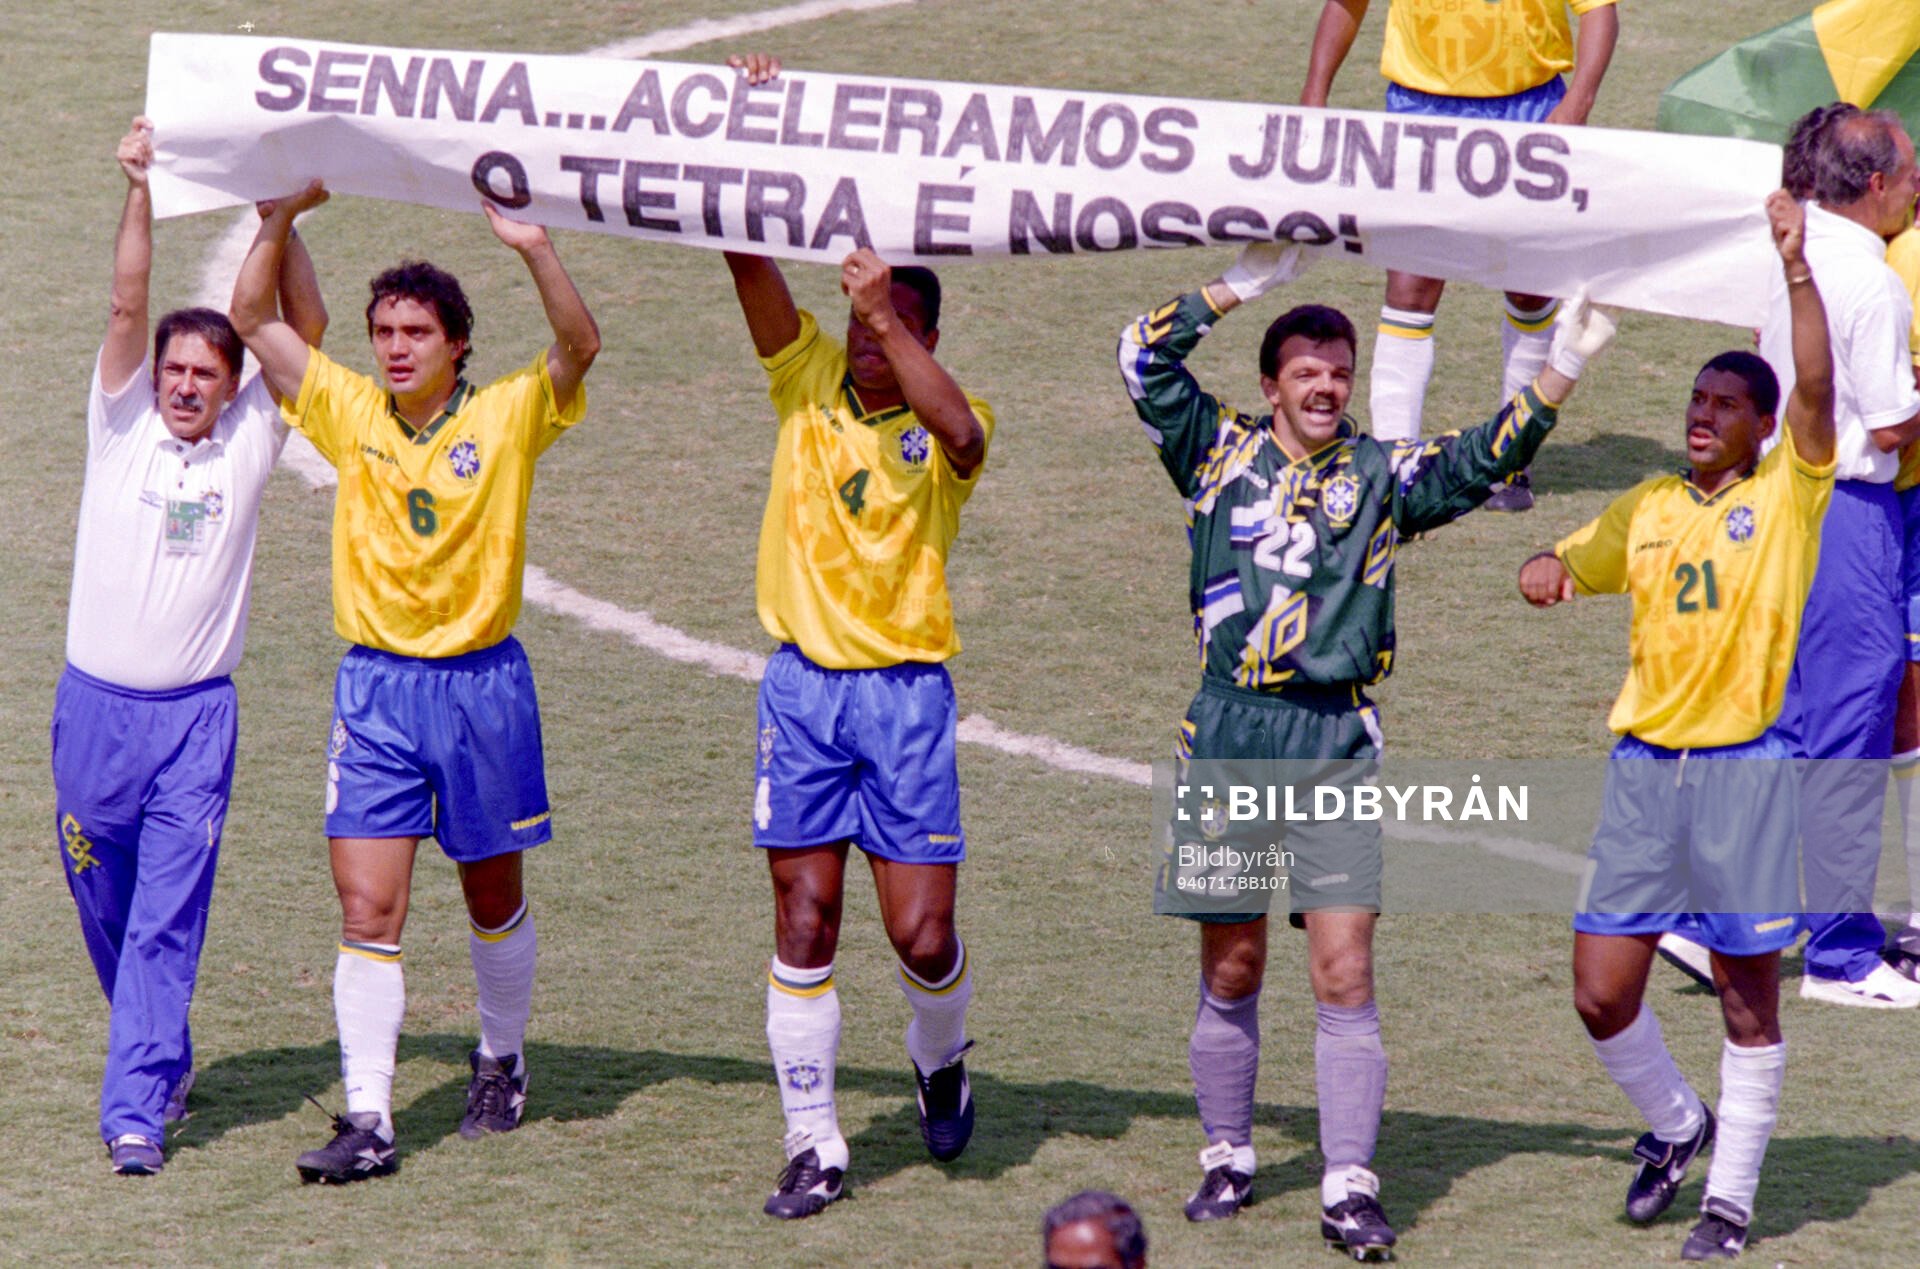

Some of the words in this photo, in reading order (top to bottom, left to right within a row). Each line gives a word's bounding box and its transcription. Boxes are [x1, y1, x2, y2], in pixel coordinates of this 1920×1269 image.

[1228, 113, 1589, 212] JUNTOS,
[471, 150, 532, 210] O
[560, 155, 877, 256] TETRA
[913, 165, 976, 256] É
[1009, 189, 1363, 254] NOSSO!
[406, 488, 437, 537] 6
[839, 468, 870, 516] 4
[1253, 515, 1317, 578] 22
[1675, 559, 1719, 613] 21
[62, 812, 101, 875] CBF
